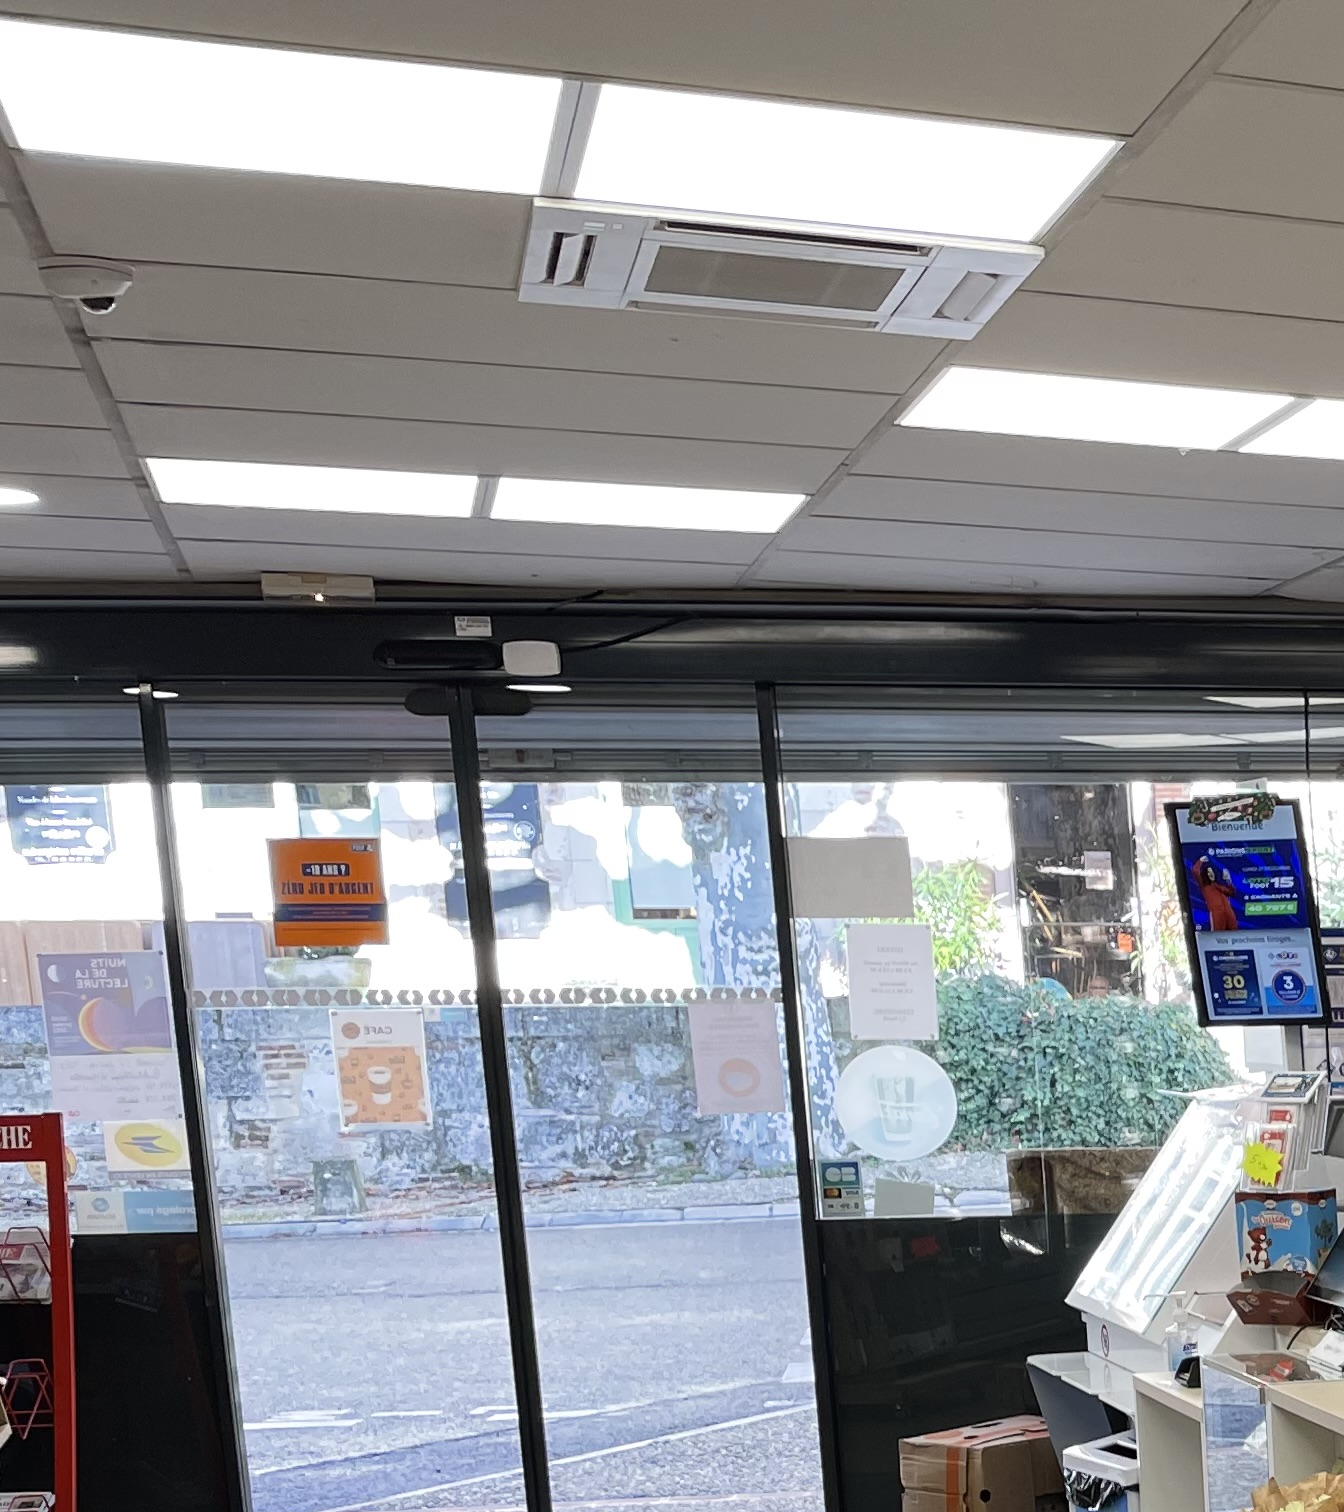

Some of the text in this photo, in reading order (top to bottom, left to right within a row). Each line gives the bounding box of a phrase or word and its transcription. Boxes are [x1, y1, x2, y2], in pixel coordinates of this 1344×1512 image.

[1270, 876, 1294, 888] 15
[1222, 975, 1245, 989] 30
[1283, 976, 1294, 989] 3
[0, 1126, 32, 1149] HE
